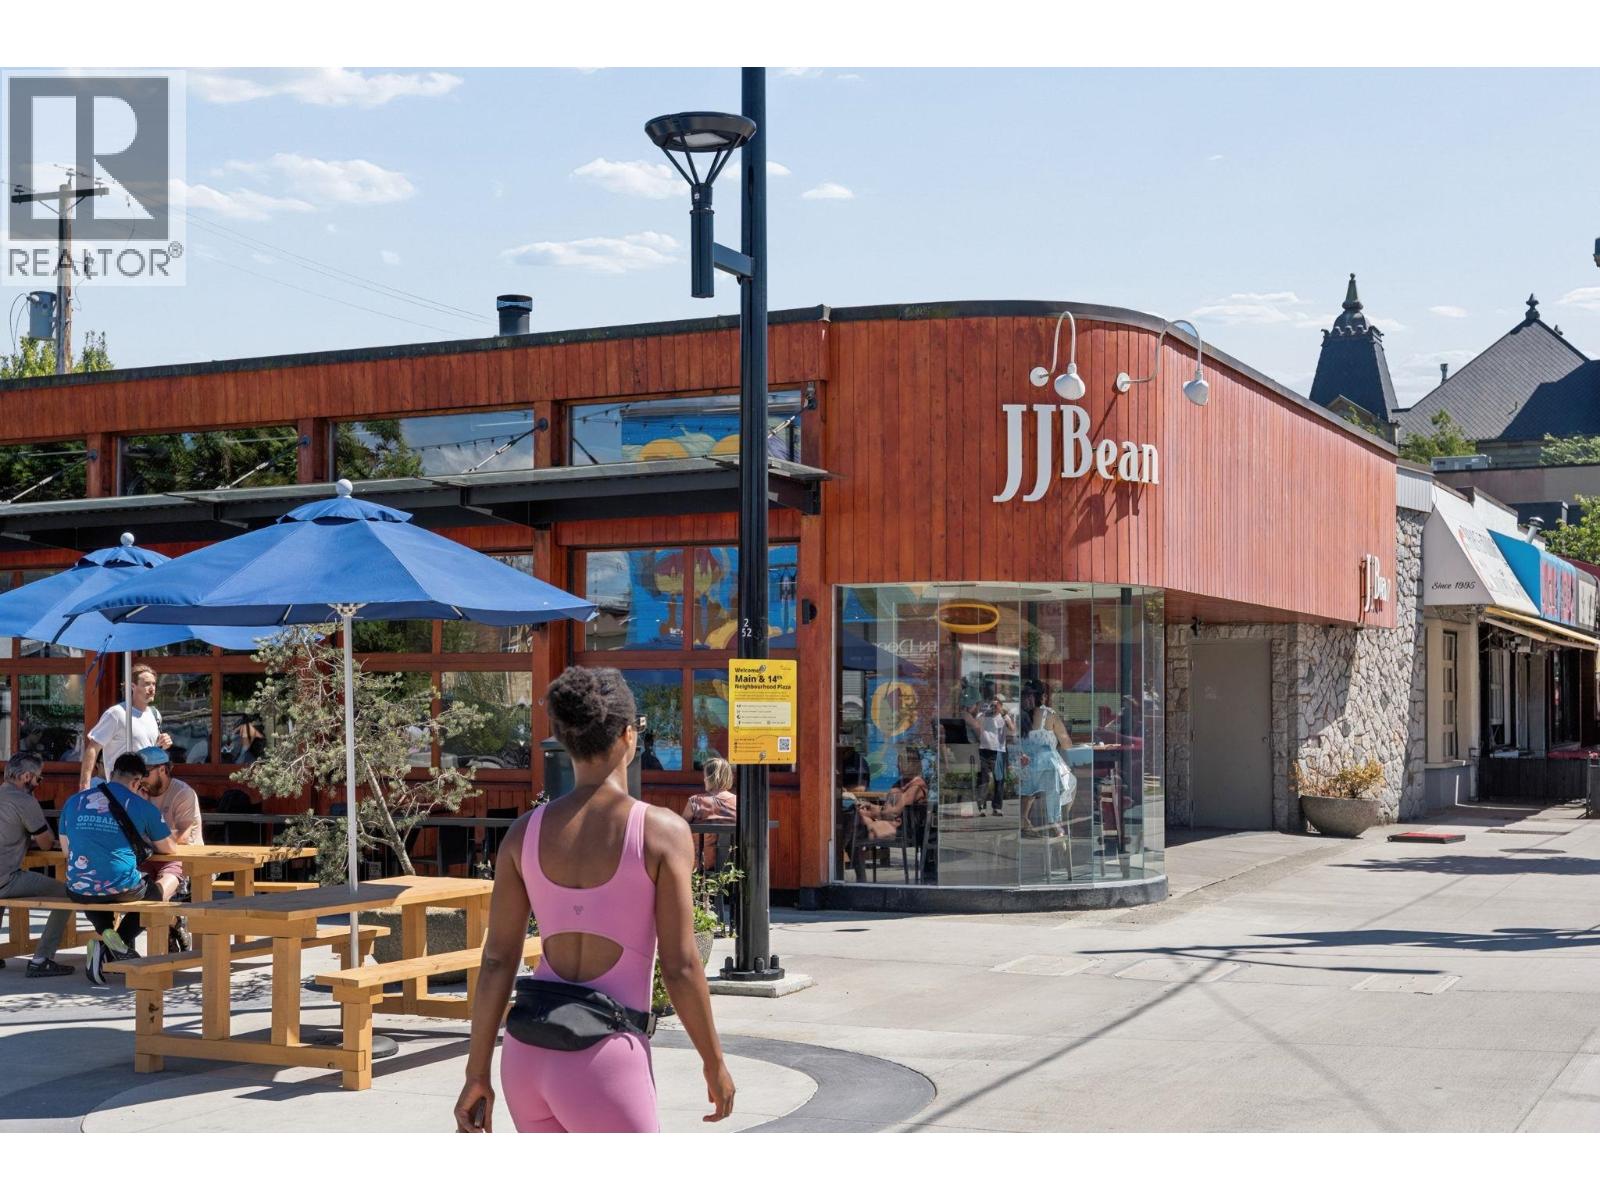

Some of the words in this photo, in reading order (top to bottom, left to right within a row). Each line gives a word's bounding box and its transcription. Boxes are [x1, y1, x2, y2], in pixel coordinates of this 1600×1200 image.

[1431, 580, 1451, 590] Since
[1455, 580, 1476, 590] 1995
[743, 618, 749, 628] 2
[741, 628, 752, 637] 52
[735, 674, 757, 683] Main
[758, 675, 765, 683] &
